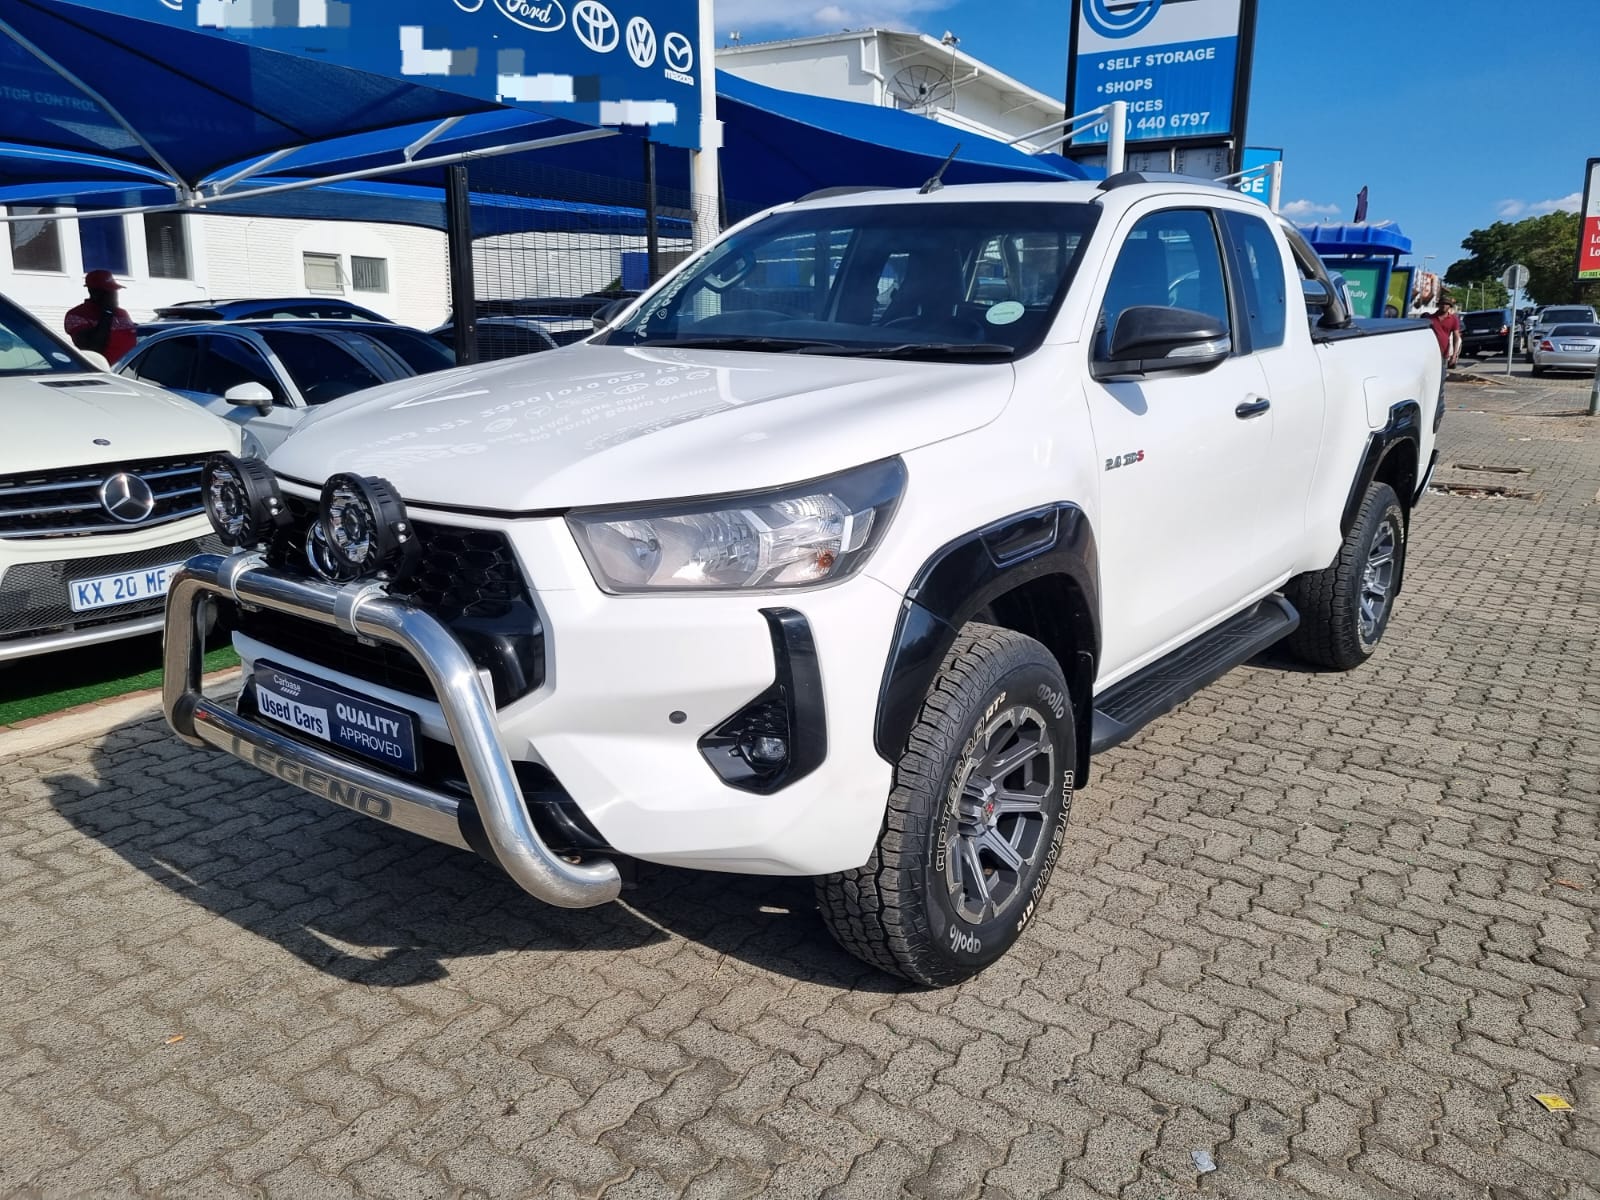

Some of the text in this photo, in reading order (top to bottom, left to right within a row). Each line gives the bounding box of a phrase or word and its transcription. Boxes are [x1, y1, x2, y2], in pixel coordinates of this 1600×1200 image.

[1106, 48, 1216, 71] SELF STORAGE
[1105, 78, 1153, 94] SHOPS
[34, 91, 100, 113] CONTROL
[1125, 99, 1164, 114] FICES
[1094, 112, 1210, 137] (0) 440 6797
[1240, 176, 1265, 194] GE
[77, 581, 104, 606] KX
[113, 576, 137, 600] 20
[261, 692, 323, 734] Used Cars
[336, 702, 400, 738] QUALITY
[340, 725, 402, 759] APPROVED
[231, 735, 392, 821] LEGEND
[950, 924, 981, 954] apollo
